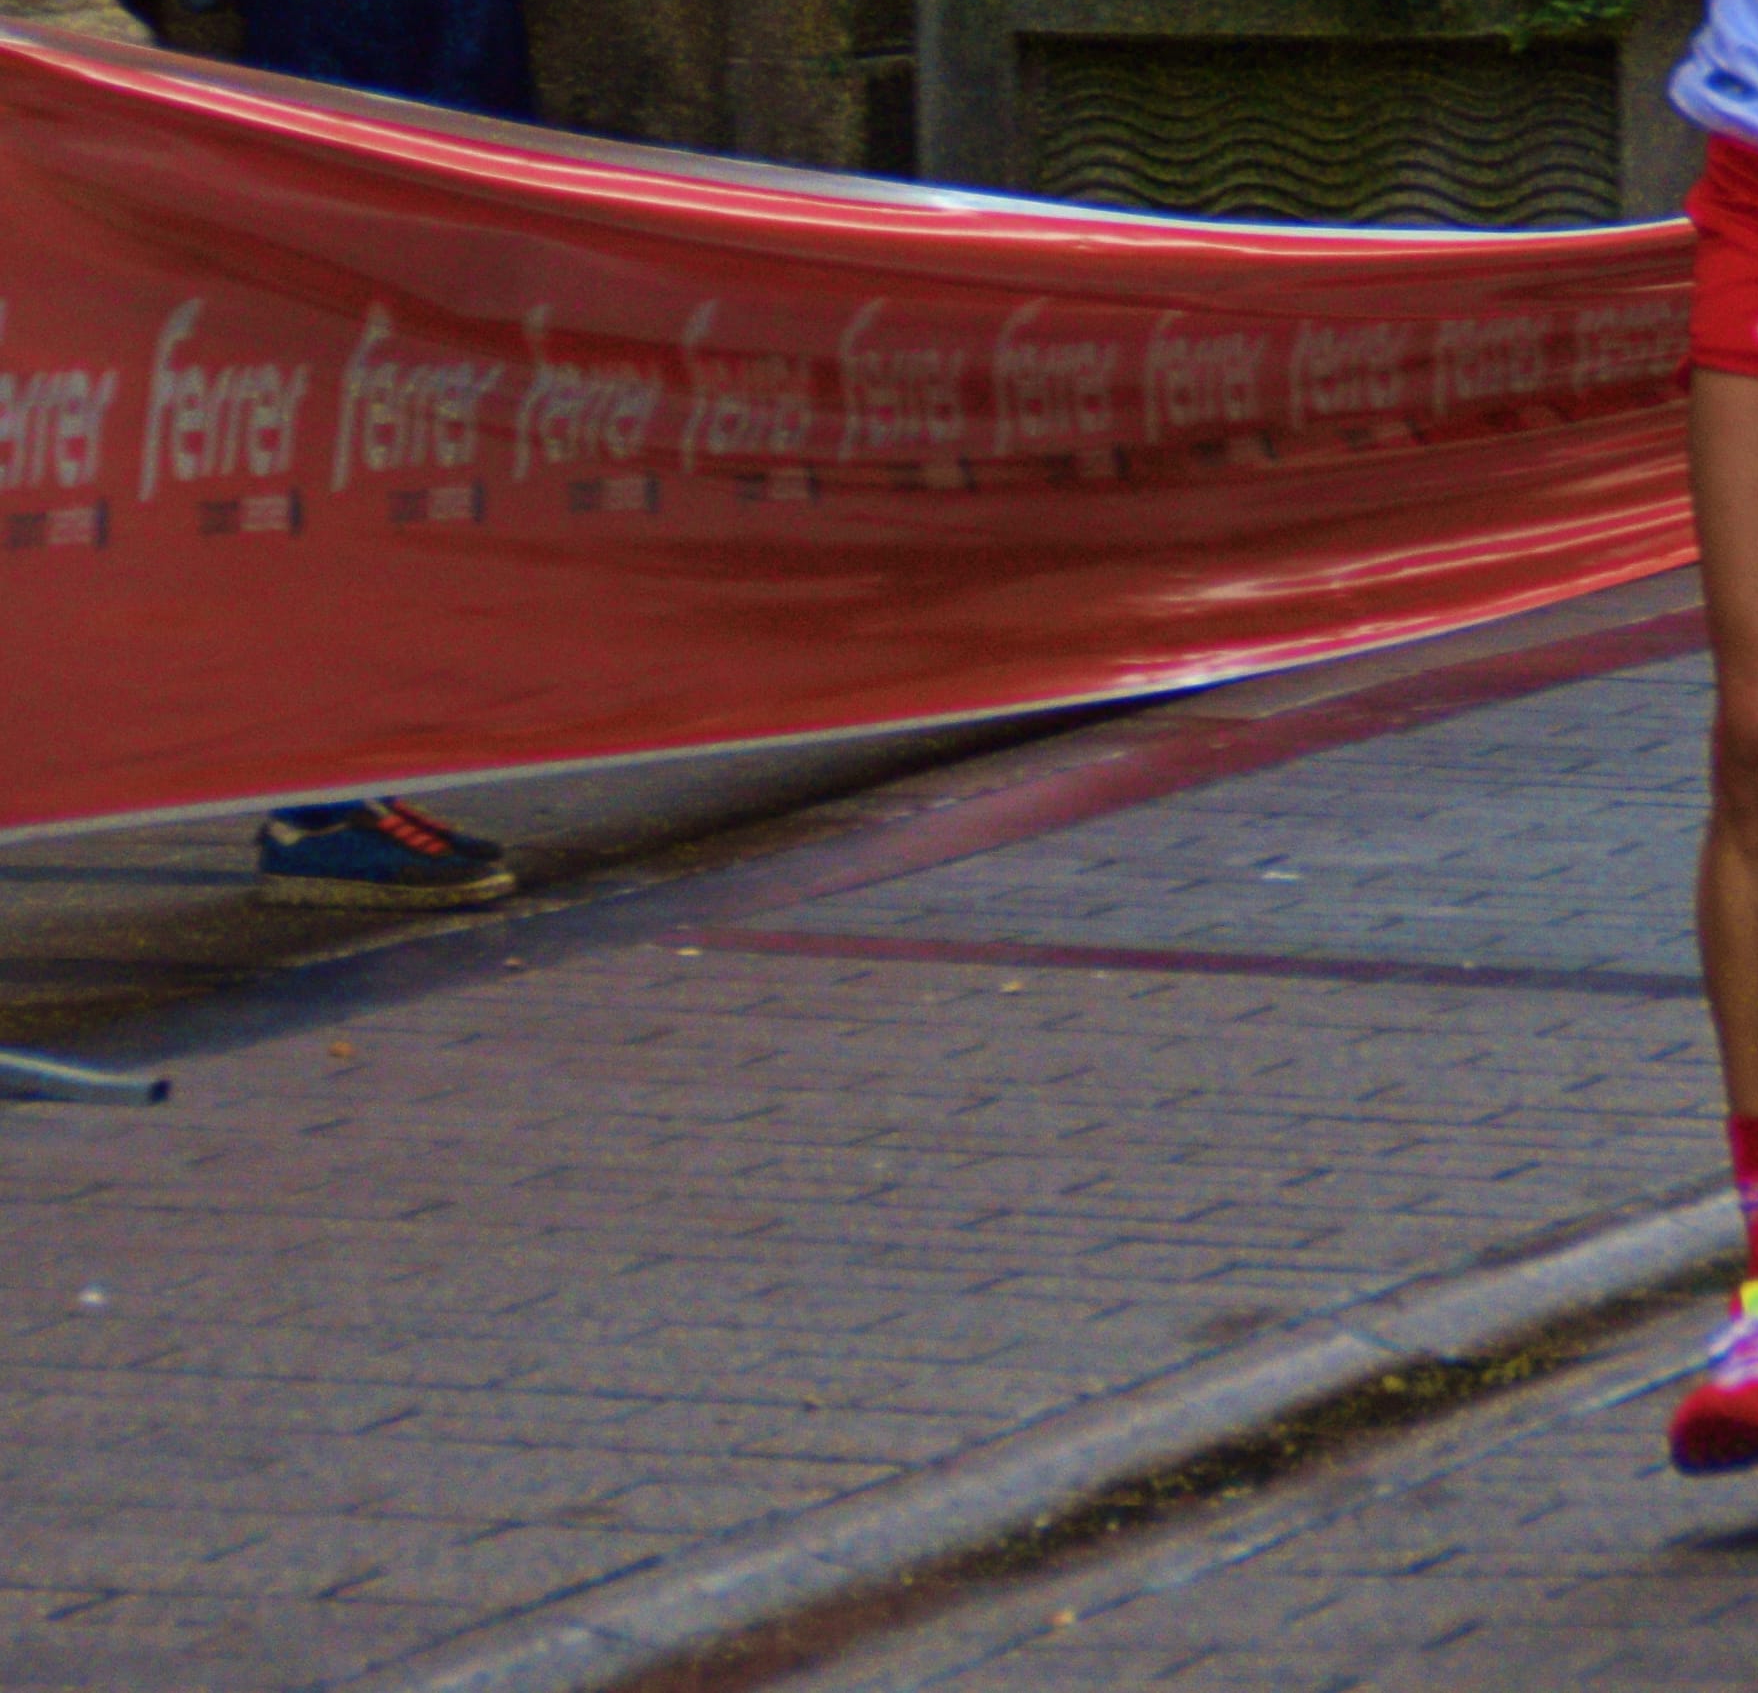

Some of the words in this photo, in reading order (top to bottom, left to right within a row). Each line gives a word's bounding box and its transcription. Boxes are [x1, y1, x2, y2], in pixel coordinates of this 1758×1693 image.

[0, 367, 118, 488] errer
[139, 297, 309, 502] ferrer
[331, 303, 505, 492] ferrer
[515, 304, 665, 479] ferrer
